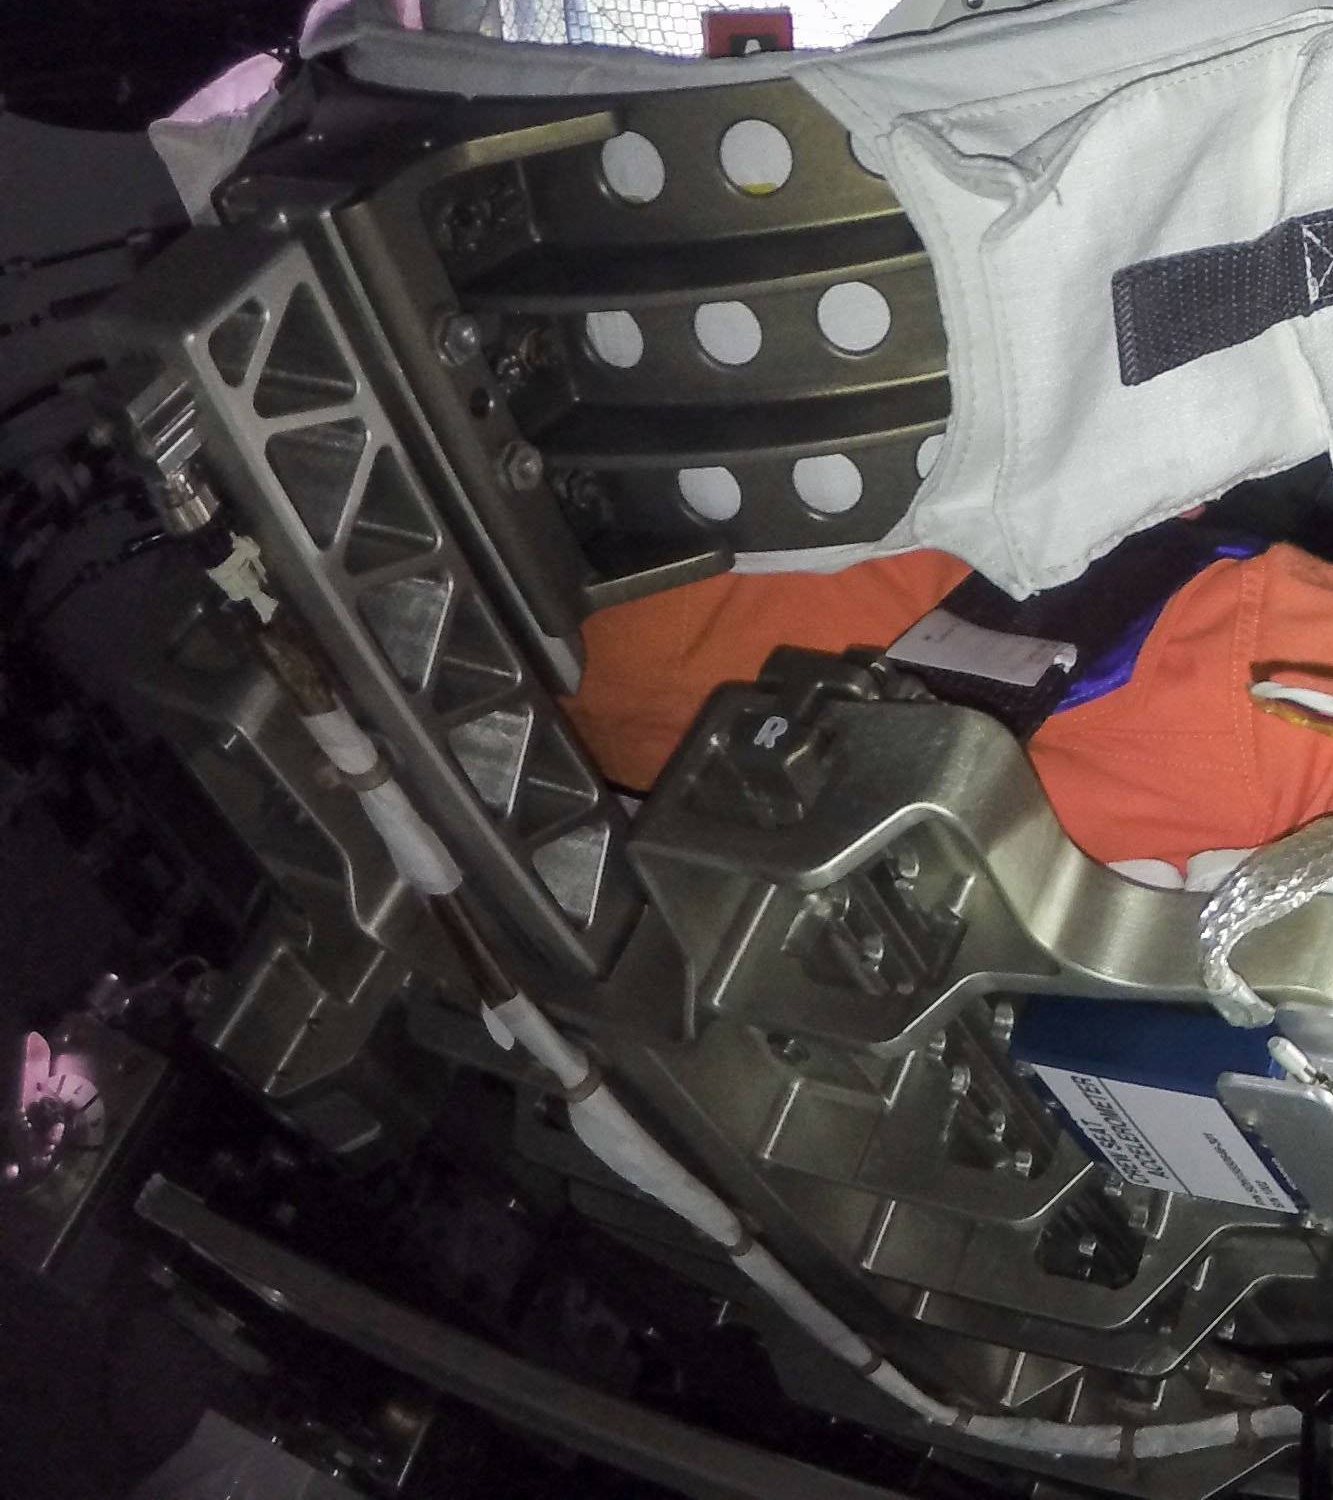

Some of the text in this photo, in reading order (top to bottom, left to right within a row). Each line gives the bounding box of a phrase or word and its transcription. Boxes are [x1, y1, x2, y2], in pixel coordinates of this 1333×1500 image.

[753, 715, 789, 749] R
[1070, 1075, 1170, 1180] ACCELEROMETER
[1080, 1118, 1150, 1185] CREW SEAT
